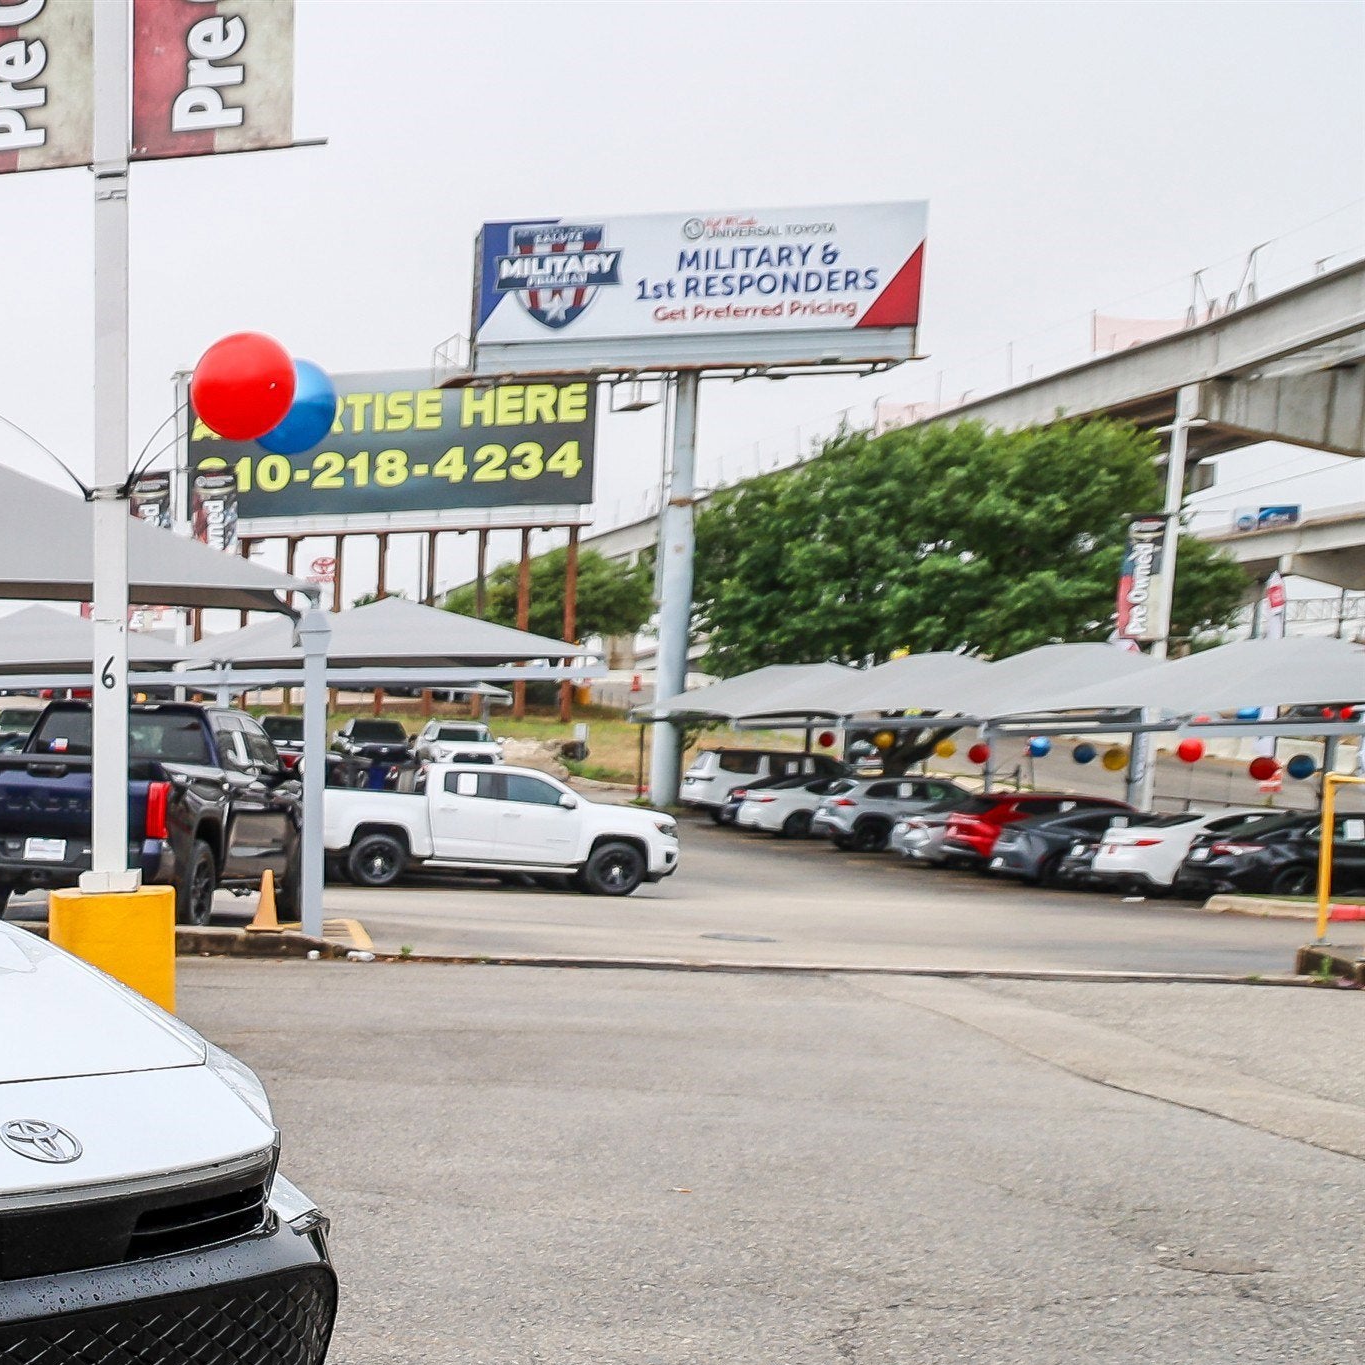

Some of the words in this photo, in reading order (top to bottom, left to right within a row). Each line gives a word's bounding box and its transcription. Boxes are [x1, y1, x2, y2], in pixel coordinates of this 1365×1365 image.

[172, 15, 247, 132] Pre
[706, 225, 782, 239] UNIVERSAL
[785, 222, 838, 236] TOYOTA
[499, 252, 617, 280] MILITARY
[677, 242, 815, 272] MILITARY
[821, 240, 841, 265] &
[636, 277, 677, 301] 1st
[684, 267, 879, 298] RESPONDERS
[653, 303, 687, 322] Get
[692, 301, 783, 319] Preferred
[789, 298, 859, 318] Pricing
[459, 382, 589, 429] HERE
[101, 655, 116, 690] 6
